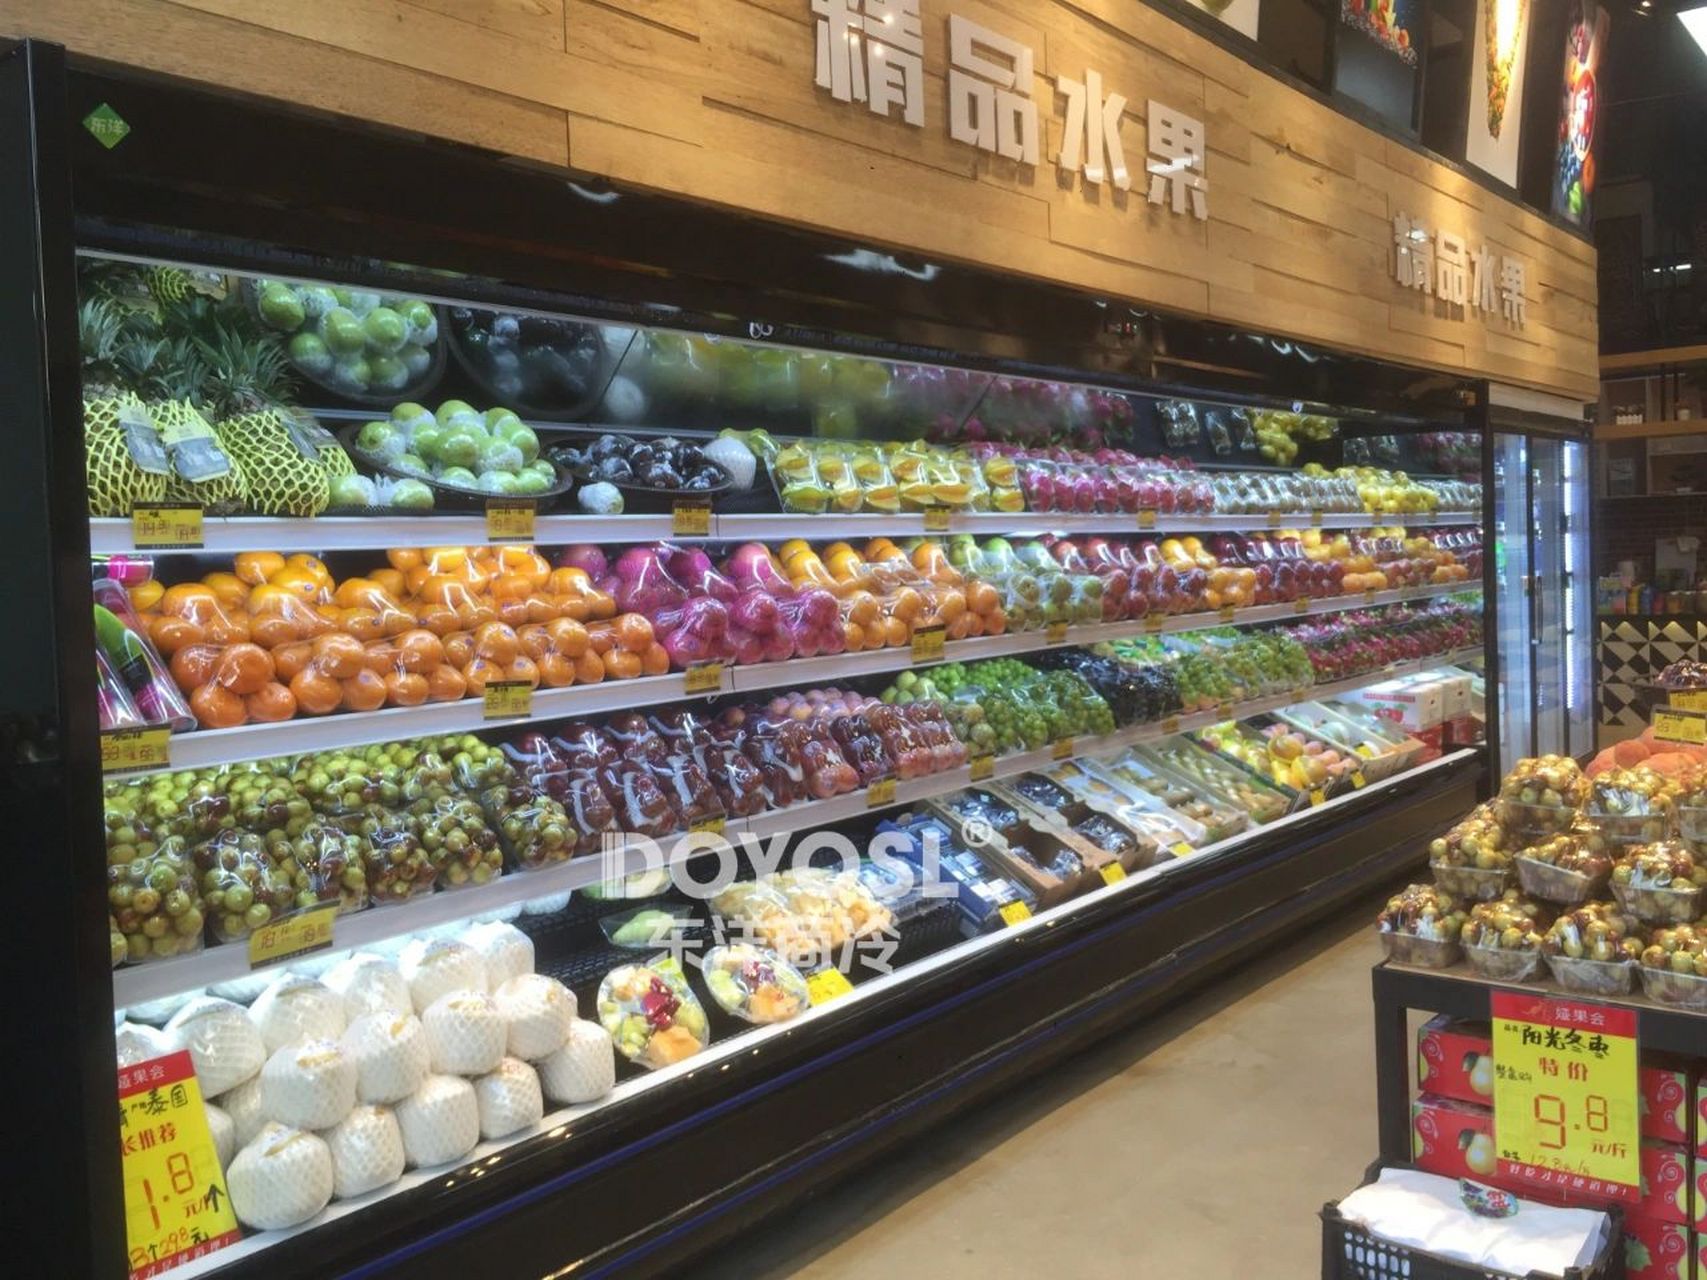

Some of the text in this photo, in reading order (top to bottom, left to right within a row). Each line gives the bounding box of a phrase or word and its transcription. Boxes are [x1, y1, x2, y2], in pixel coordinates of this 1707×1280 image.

[812, 0, 1209, 221] 精品水果
[1394, 211, 1526, 326] 精品水果
[1522, 1025, 1610, 1059] 阳光冬枣
[1539, 1057, 1588, 1082] 特价
[145, 1084, 189, 1117] 泰国
[1534, 1094, 1608, 1150] 9.8
